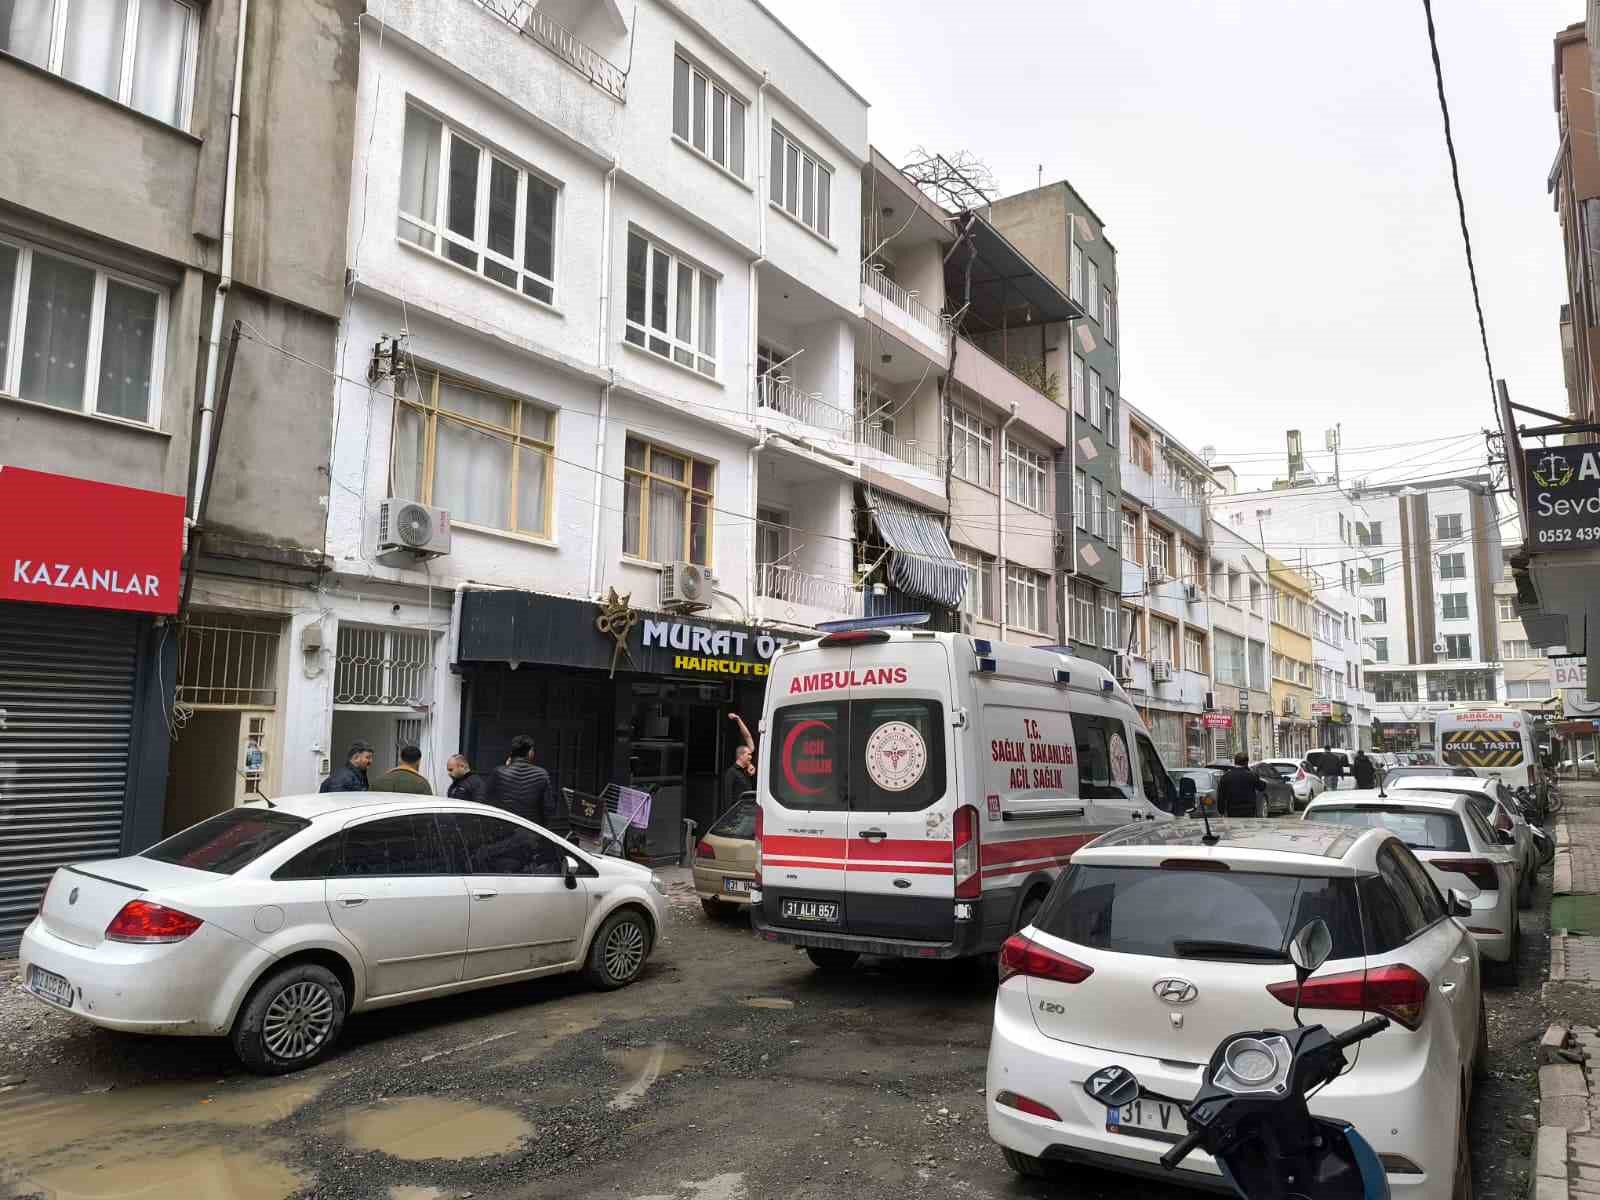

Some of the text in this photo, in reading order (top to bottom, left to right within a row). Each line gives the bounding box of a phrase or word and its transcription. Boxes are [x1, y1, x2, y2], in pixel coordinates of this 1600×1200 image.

[1578, 452, 1600, 481] A
[1538, 529, 1572, 543] 0552
[13, 559, 160, 597] KAZANLAR
[643, 619, 748, 657] MURAT
[789, 667, 907, 695] AMBULANS
[1023, 718, 1042, 739] T.C.
[991, 738, 1073, 765] SAĞLIK BAKANLIĞI
[1445, 740, 1521, 751] OKUL TAŞITI
[1009, 765, 1063, 789] ACİL SAĞLIK
[787, 902, 835, 919] 31 ALH 857
[1121, 1100, 1142, 1125] 31
